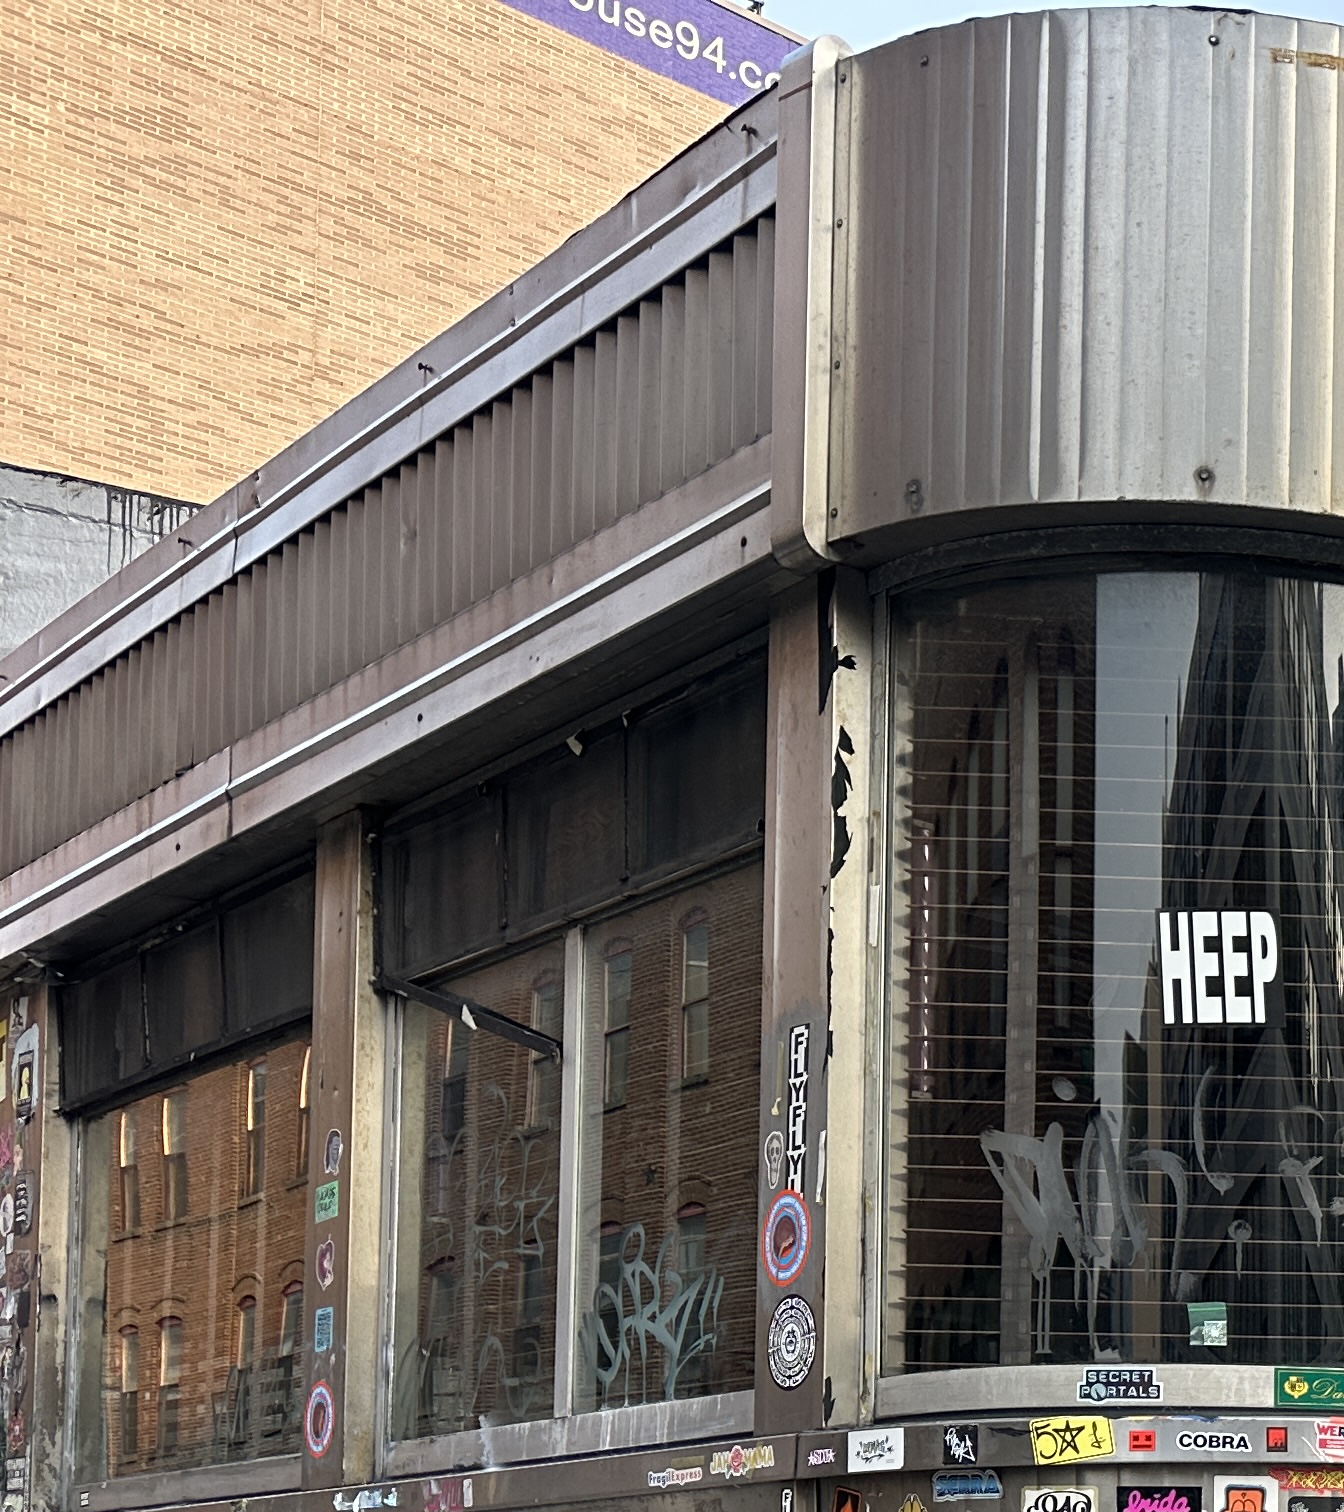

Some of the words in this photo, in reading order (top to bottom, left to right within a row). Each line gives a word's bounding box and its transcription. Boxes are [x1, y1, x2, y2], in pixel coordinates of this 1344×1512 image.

[1159, 911, 1278, 1024] HEEP
[1087, 1371, 1151, 1383] SECRET
[1080, 1384, 1160, 1399] PORTALS
[1178, 1433, 1249, 1451] COBRA
